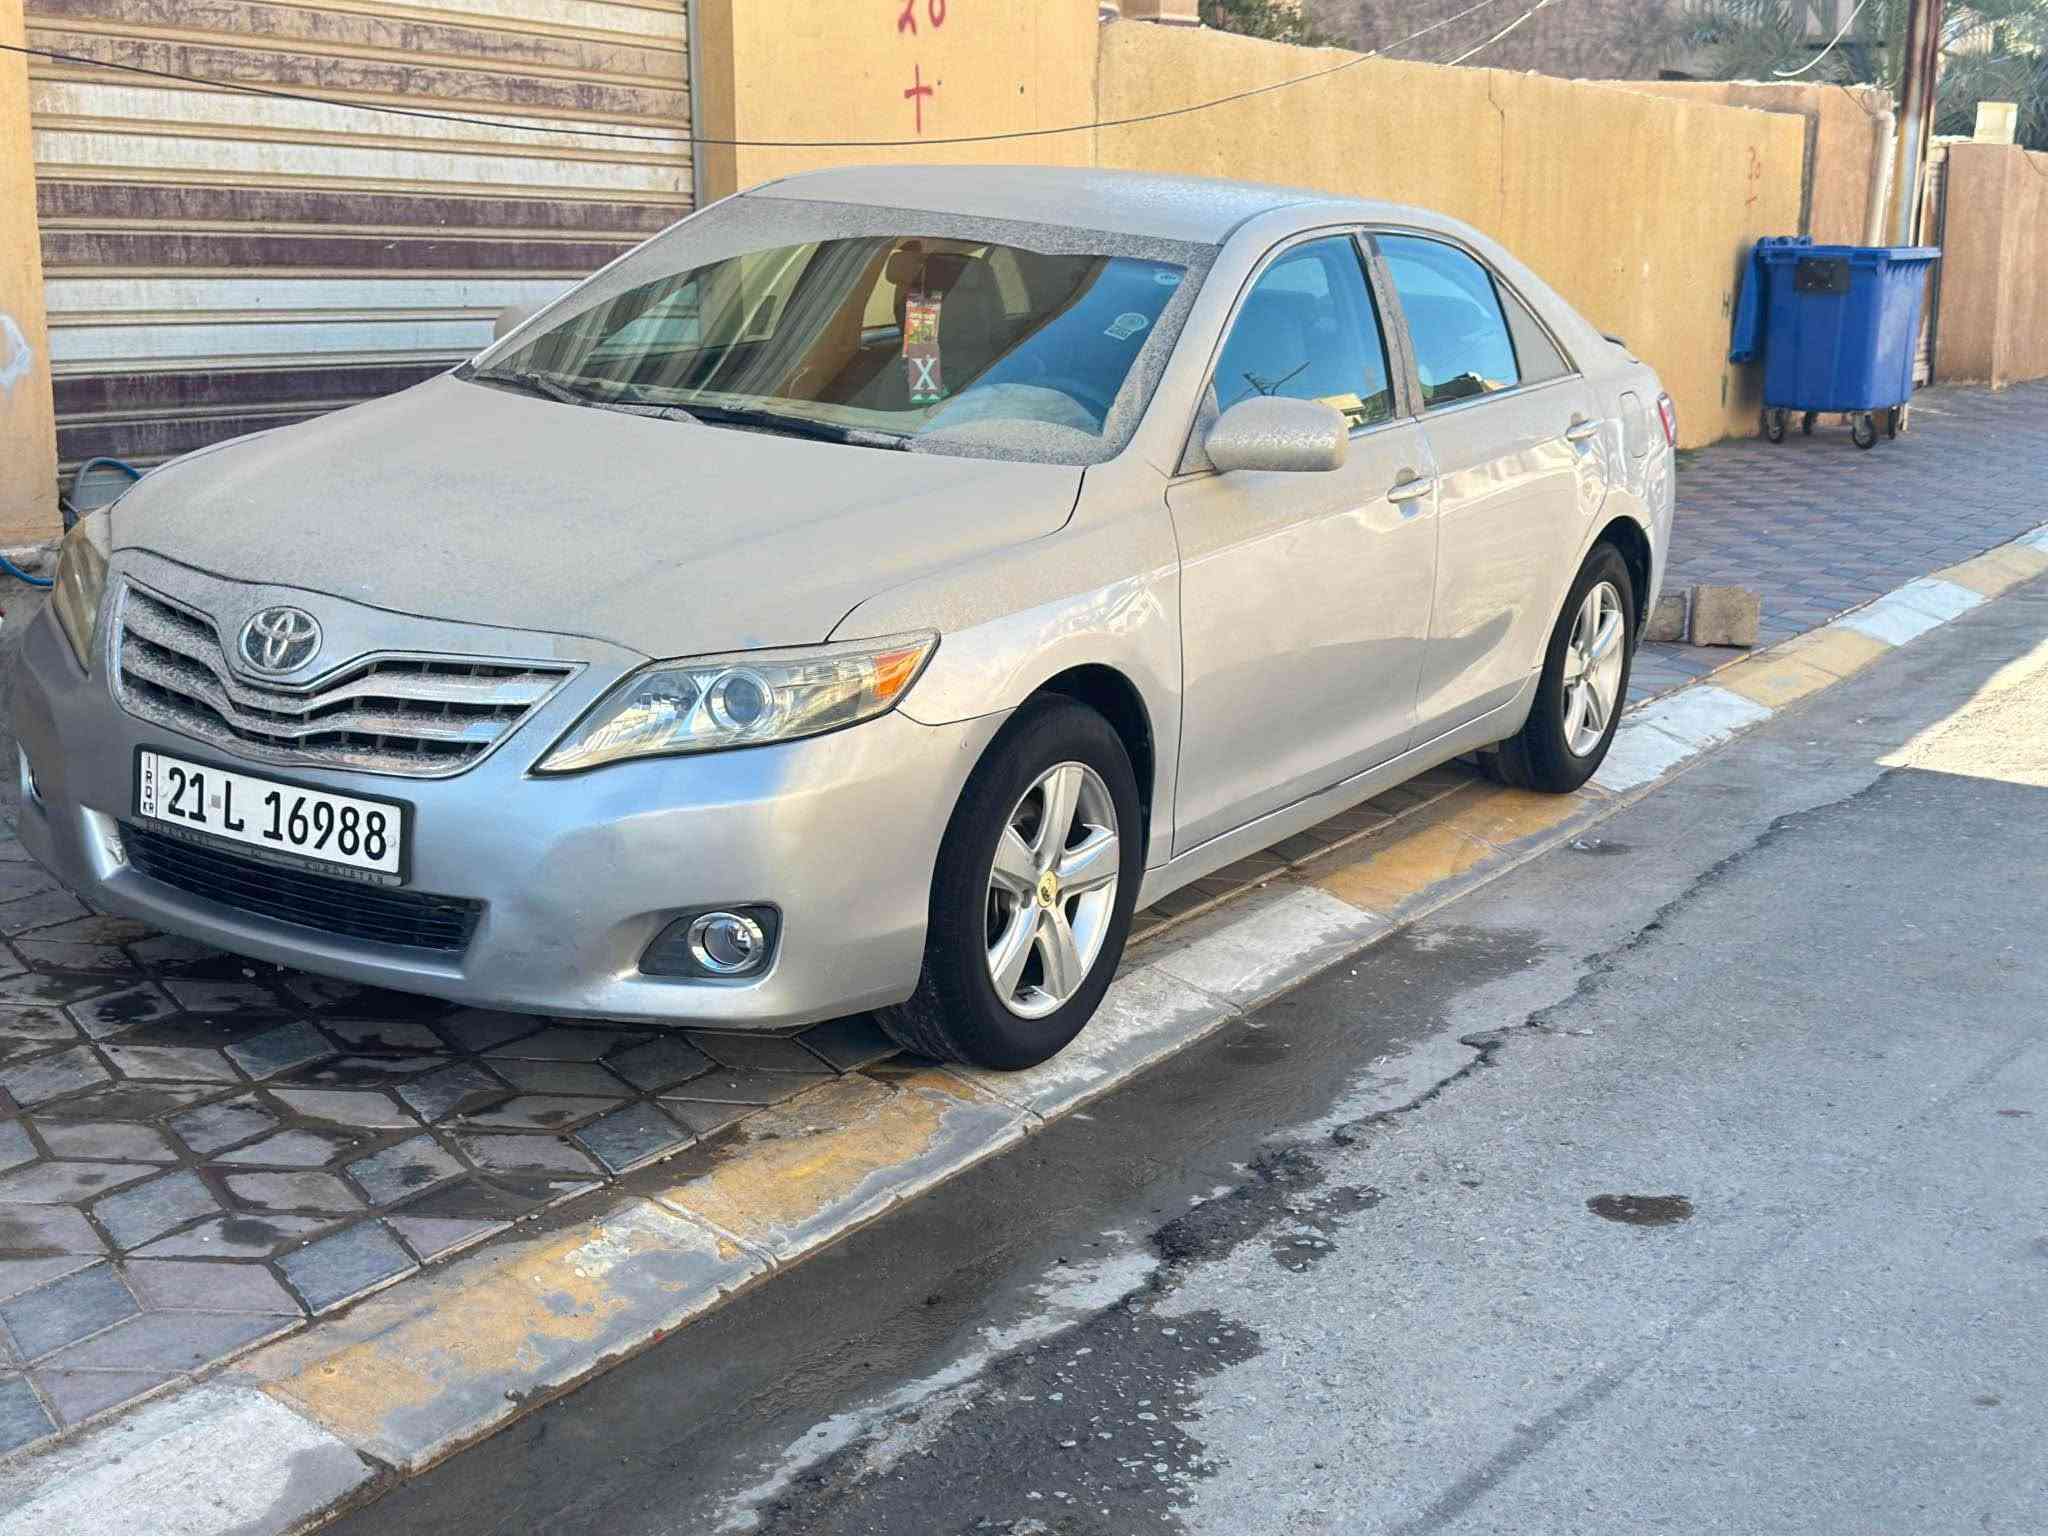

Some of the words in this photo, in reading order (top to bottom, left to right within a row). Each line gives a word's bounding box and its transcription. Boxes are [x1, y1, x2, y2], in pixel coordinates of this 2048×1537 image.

[168, 767, 207, 823] 21
[225, 781, 244, 831] L
[263, 791, 387, 860] 16988
